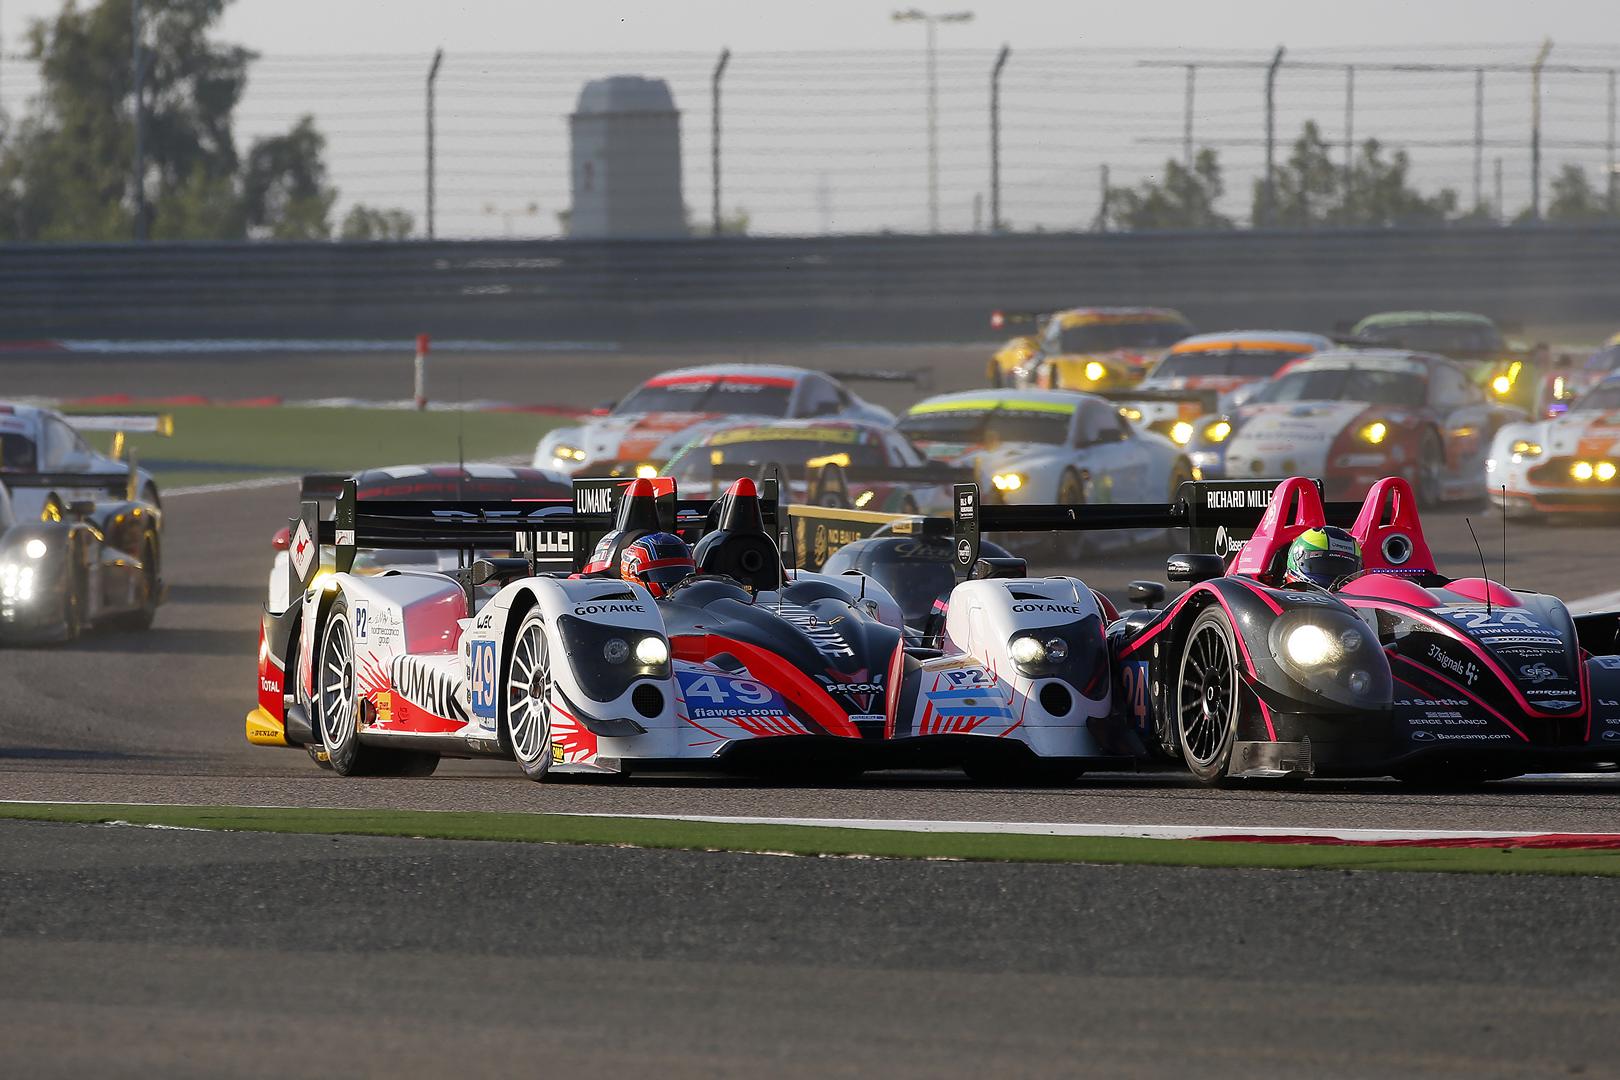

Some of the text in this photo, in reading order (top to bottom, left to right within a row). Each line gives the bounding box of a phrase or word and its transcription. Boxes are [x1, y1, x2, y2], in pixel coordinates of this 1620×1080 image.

[577, 488, 612, 514] LUMAIKE
[1207, 490, 1273, 509] RICHARD MILLE
[574, 604, 646, 616] GOYAIKE
[1012, 604, 1081, 615] GOYAIKE
[356, 607, 367, 638] P2
[1453, 612, 1539, 629] 24
[1427, 643, 1464, 676] 37signals
[472, 645, 495, 708] 49
[947, 669, 989, 685] P2
[261, 677, 280, 693] TOTAL
[685, 675, 773, 705] 49
[827, 683, 884, 692] PECOM
[1122, 666, 1147, 729] 24
[1413, 698, 1469, 706] Sarthe
[694, 708, 784, 718] fiawec.com
[1437, 733, 1512, 741] Basecamp.com
